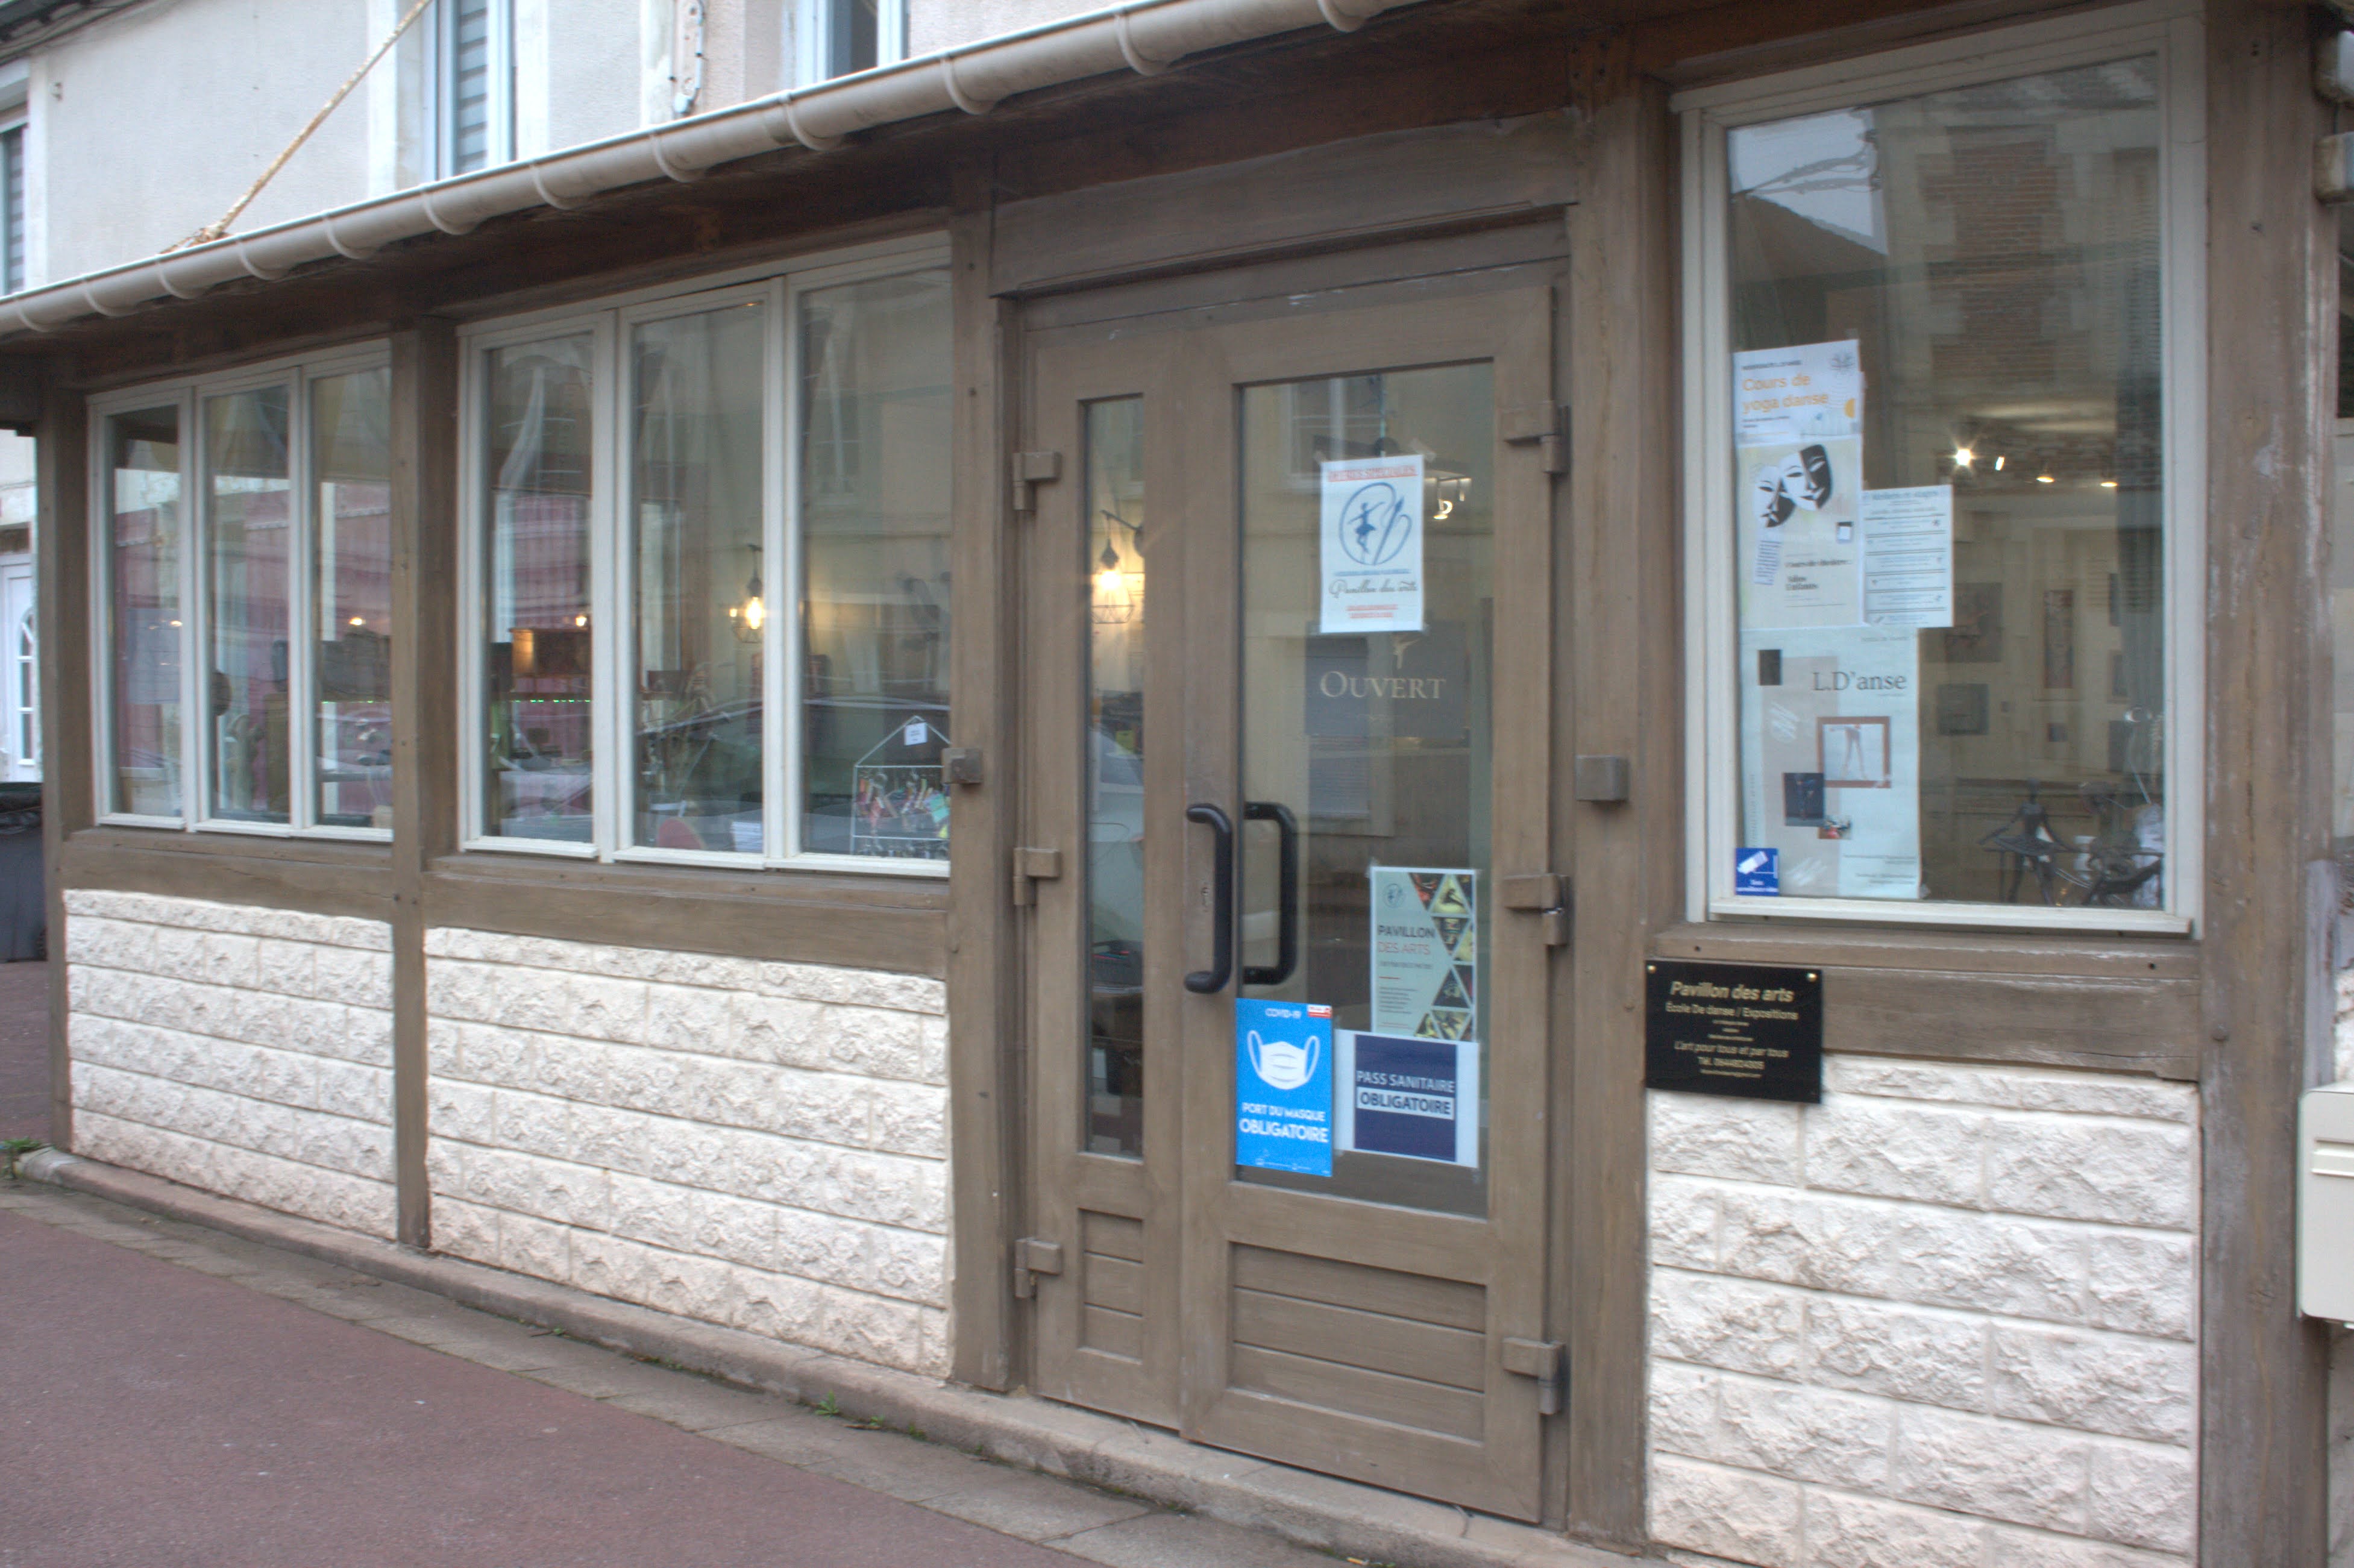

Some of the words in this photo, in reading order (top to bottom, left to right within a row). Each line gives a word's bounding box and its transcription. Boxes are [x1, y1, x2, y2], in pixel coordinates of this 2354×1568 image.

[1742, 378, 1787, 392] Cours
[1791, 372, 1811, 387] de
[1743, 398, 1780, 415] yoga
[1782, 394, 1829, 408] danse
[1378, 924, 1436, 939] PAVILLON
[1378, 941, 1399, 953] DES
[1401, 943, 1431, 955] ARTS
[1670, 980, 1730, 999] Pavillon
[1731, 984, 1760, 1000] des
[1762, 988, 1795, 1003] arts
[1266, 1008, 1302, 1020] COVID-19
[1706, 1005, 1736, 1017] danse
[1742, 1007, 1800, 1020] Expositions
[1695, 1044, 1716, 1053] pour
[1717, 1044, 1738, 1054] tous
[1356, 1070, 1386, 1085] PASS
[1388, 1074, 1455, 1093] SANITAIRE
[1241, 1102, 1267, 1115] PORT
[1269, 1105, 1284, 1117] DU
[1284, 1108, 1325, 1122] MASQUE
[1360, 1091, 1451, 1115] OBLIGATOIRE
[1238, 1118, 1329, 1143] OBLIGATOIRE
